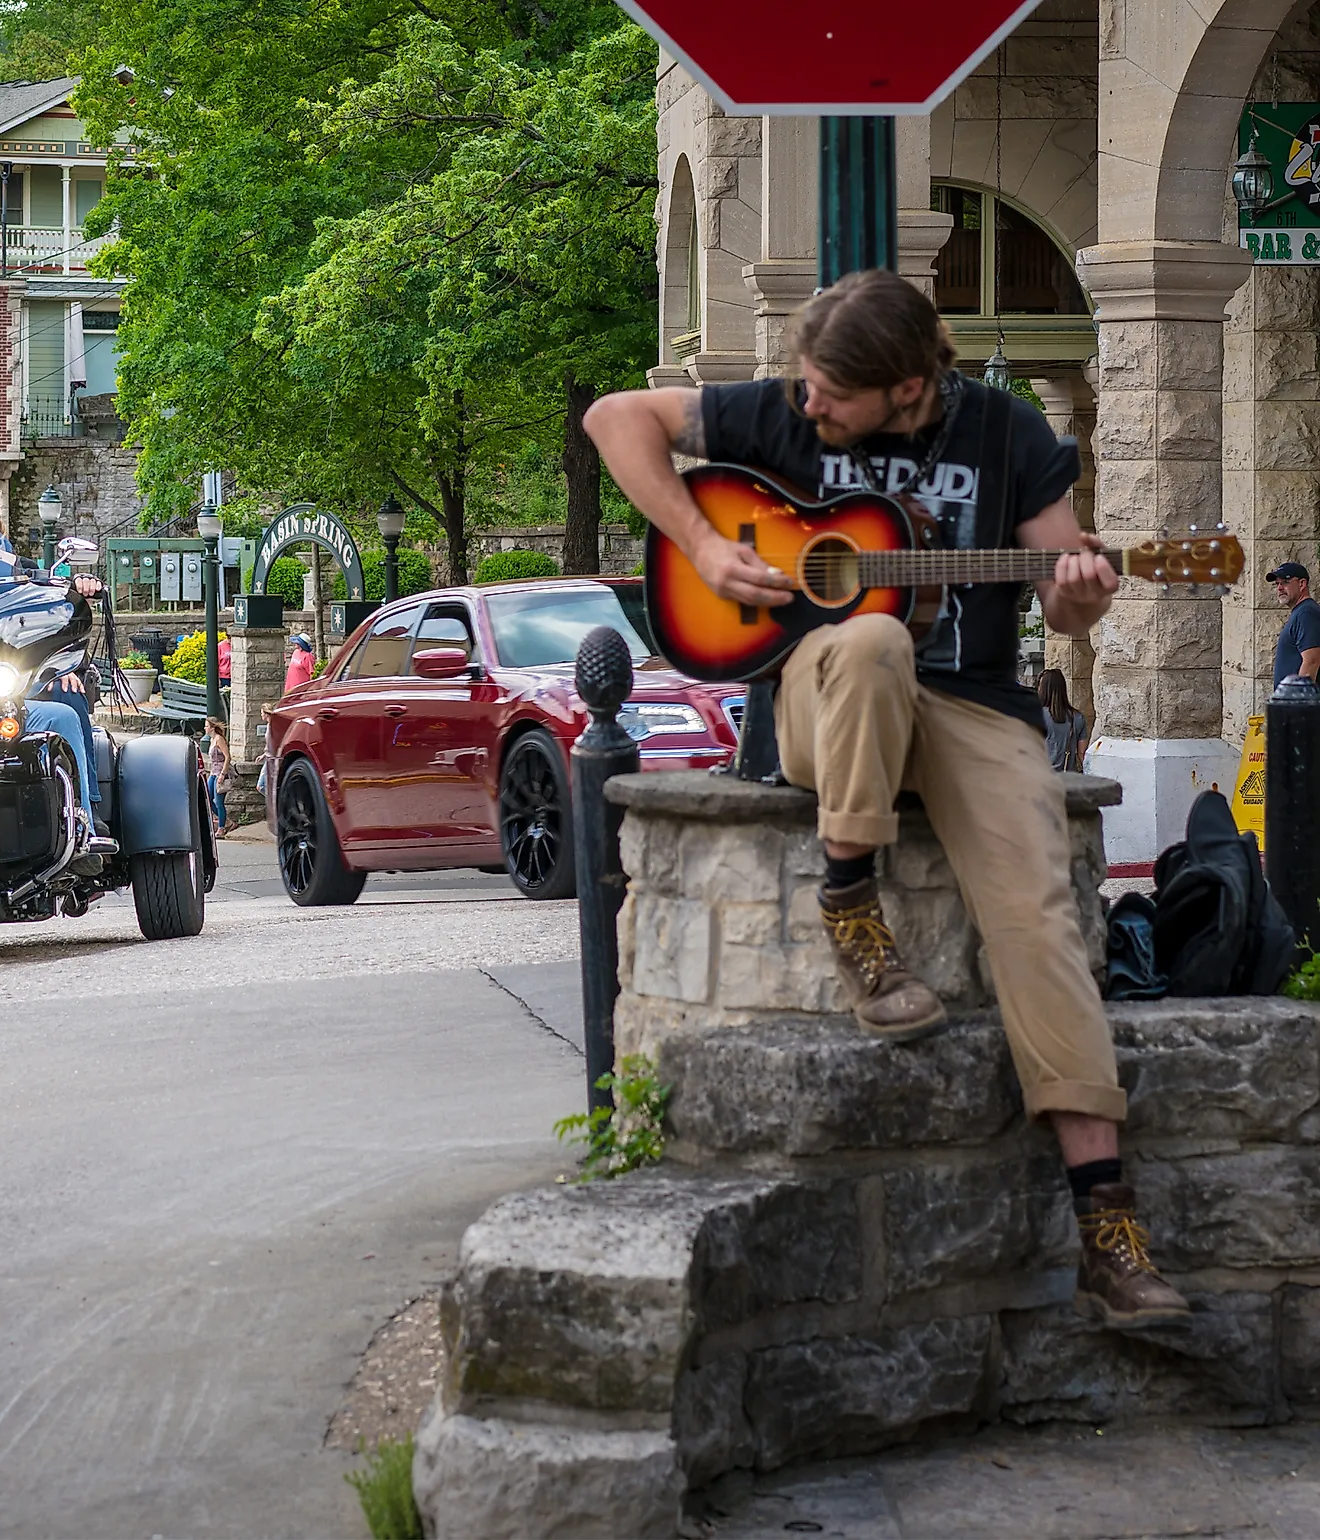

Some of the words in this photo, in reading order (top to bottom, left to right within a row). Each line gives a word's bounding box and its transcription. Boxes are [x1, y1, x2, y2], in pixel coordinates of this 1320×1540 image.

[1246, 232, 1292, 260] BAR
[886, 456, 980, 501] DUD
[260, 512, 300, 568] BASIN
[303, 513, 353, 569] SPRING
